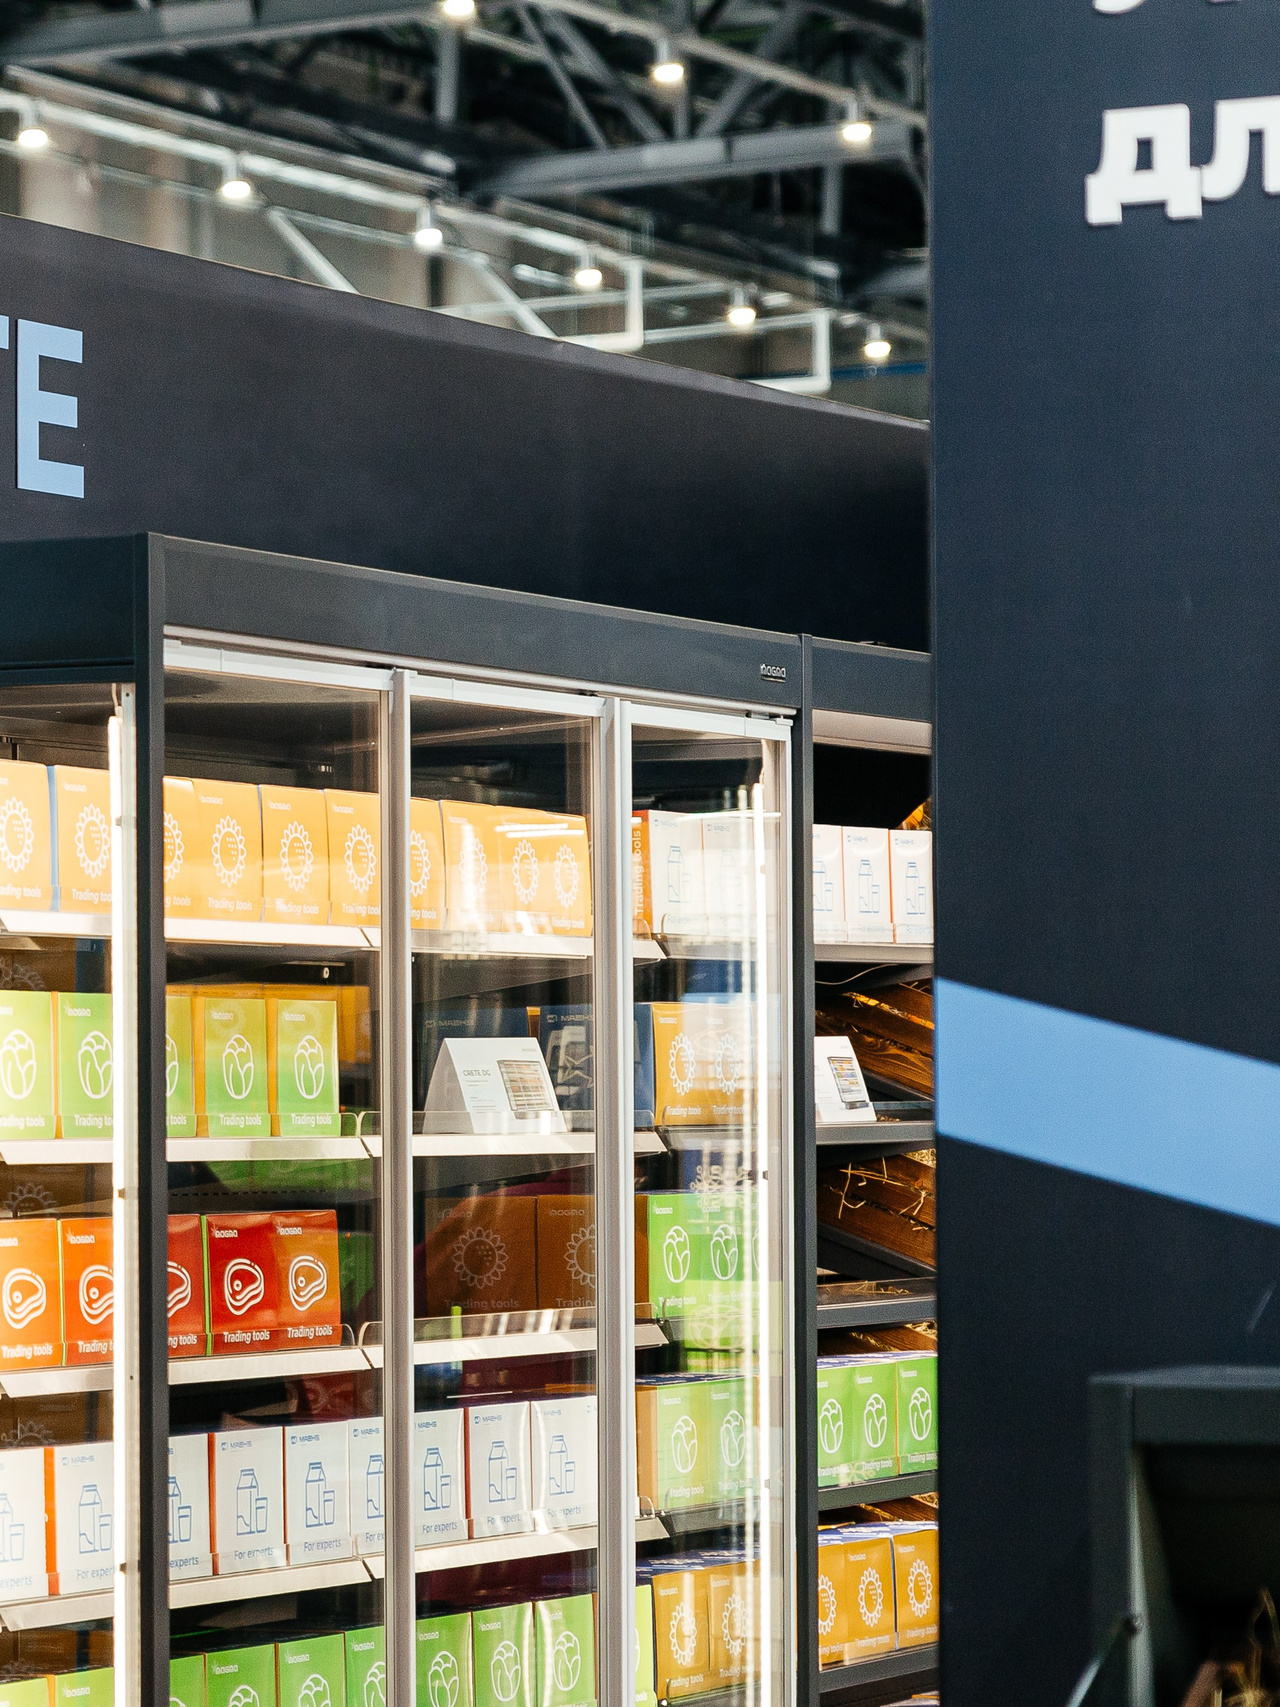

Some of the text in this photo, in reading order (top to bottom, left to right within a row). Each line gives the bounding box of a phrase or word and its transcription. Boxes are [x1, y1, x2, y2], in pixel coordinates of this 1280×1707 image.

[24, 886, 42, 898] tools
[72, 889, 99, 904] Trading
[173, 896, 191, 907] tools
[208, 896, 253, 912] Trading tools
[303, 903, 319, 914] tools
[368, 906, 380, 915] tool
[666, 1105, 702, 1117] Trading tools
[713, 1105, 733, 1117] Trading
[26, 1115, 46, 1127] tools
[74, 1114, 104, 1128] Trading
[171, 1115, 187, 1125] tools
[220, 1113, 262, 1129] Trading tools
[291, 1113, 332, 1127] Trading tools
[491, 1299, 520, 1308] tools
[179, 1333, 197, 1345] tools
[223, 1329, 270, 1345] Trading tools
[287, 1325, 333, 1340] Trading tools
[2, 1345, 53, 1360] Trading tools
[78, 1339, 108, 1355] Trading
[861, 1458, 893, 1471] Trading tools
[907, 1453, 925, 1465] Trading
[670, 1485, 704, 1499] Trading tools
[422, 1521, 458, 1534] For experts
[365, 1531, 376, 1542] For
[304, 1538, 341, 1552] For experts
[234, 1546, 274, 1560] For experts
[170, 1556, 199, 1569] experts
[76, 1565, 114, 1580] For exper
[0, 1576, 33, 1589] experts
[907, 1627, 924, 1639] Trading
[855, 1634, 890, 1648] Trading tools
[690, 1674, 704, 1684] tools
